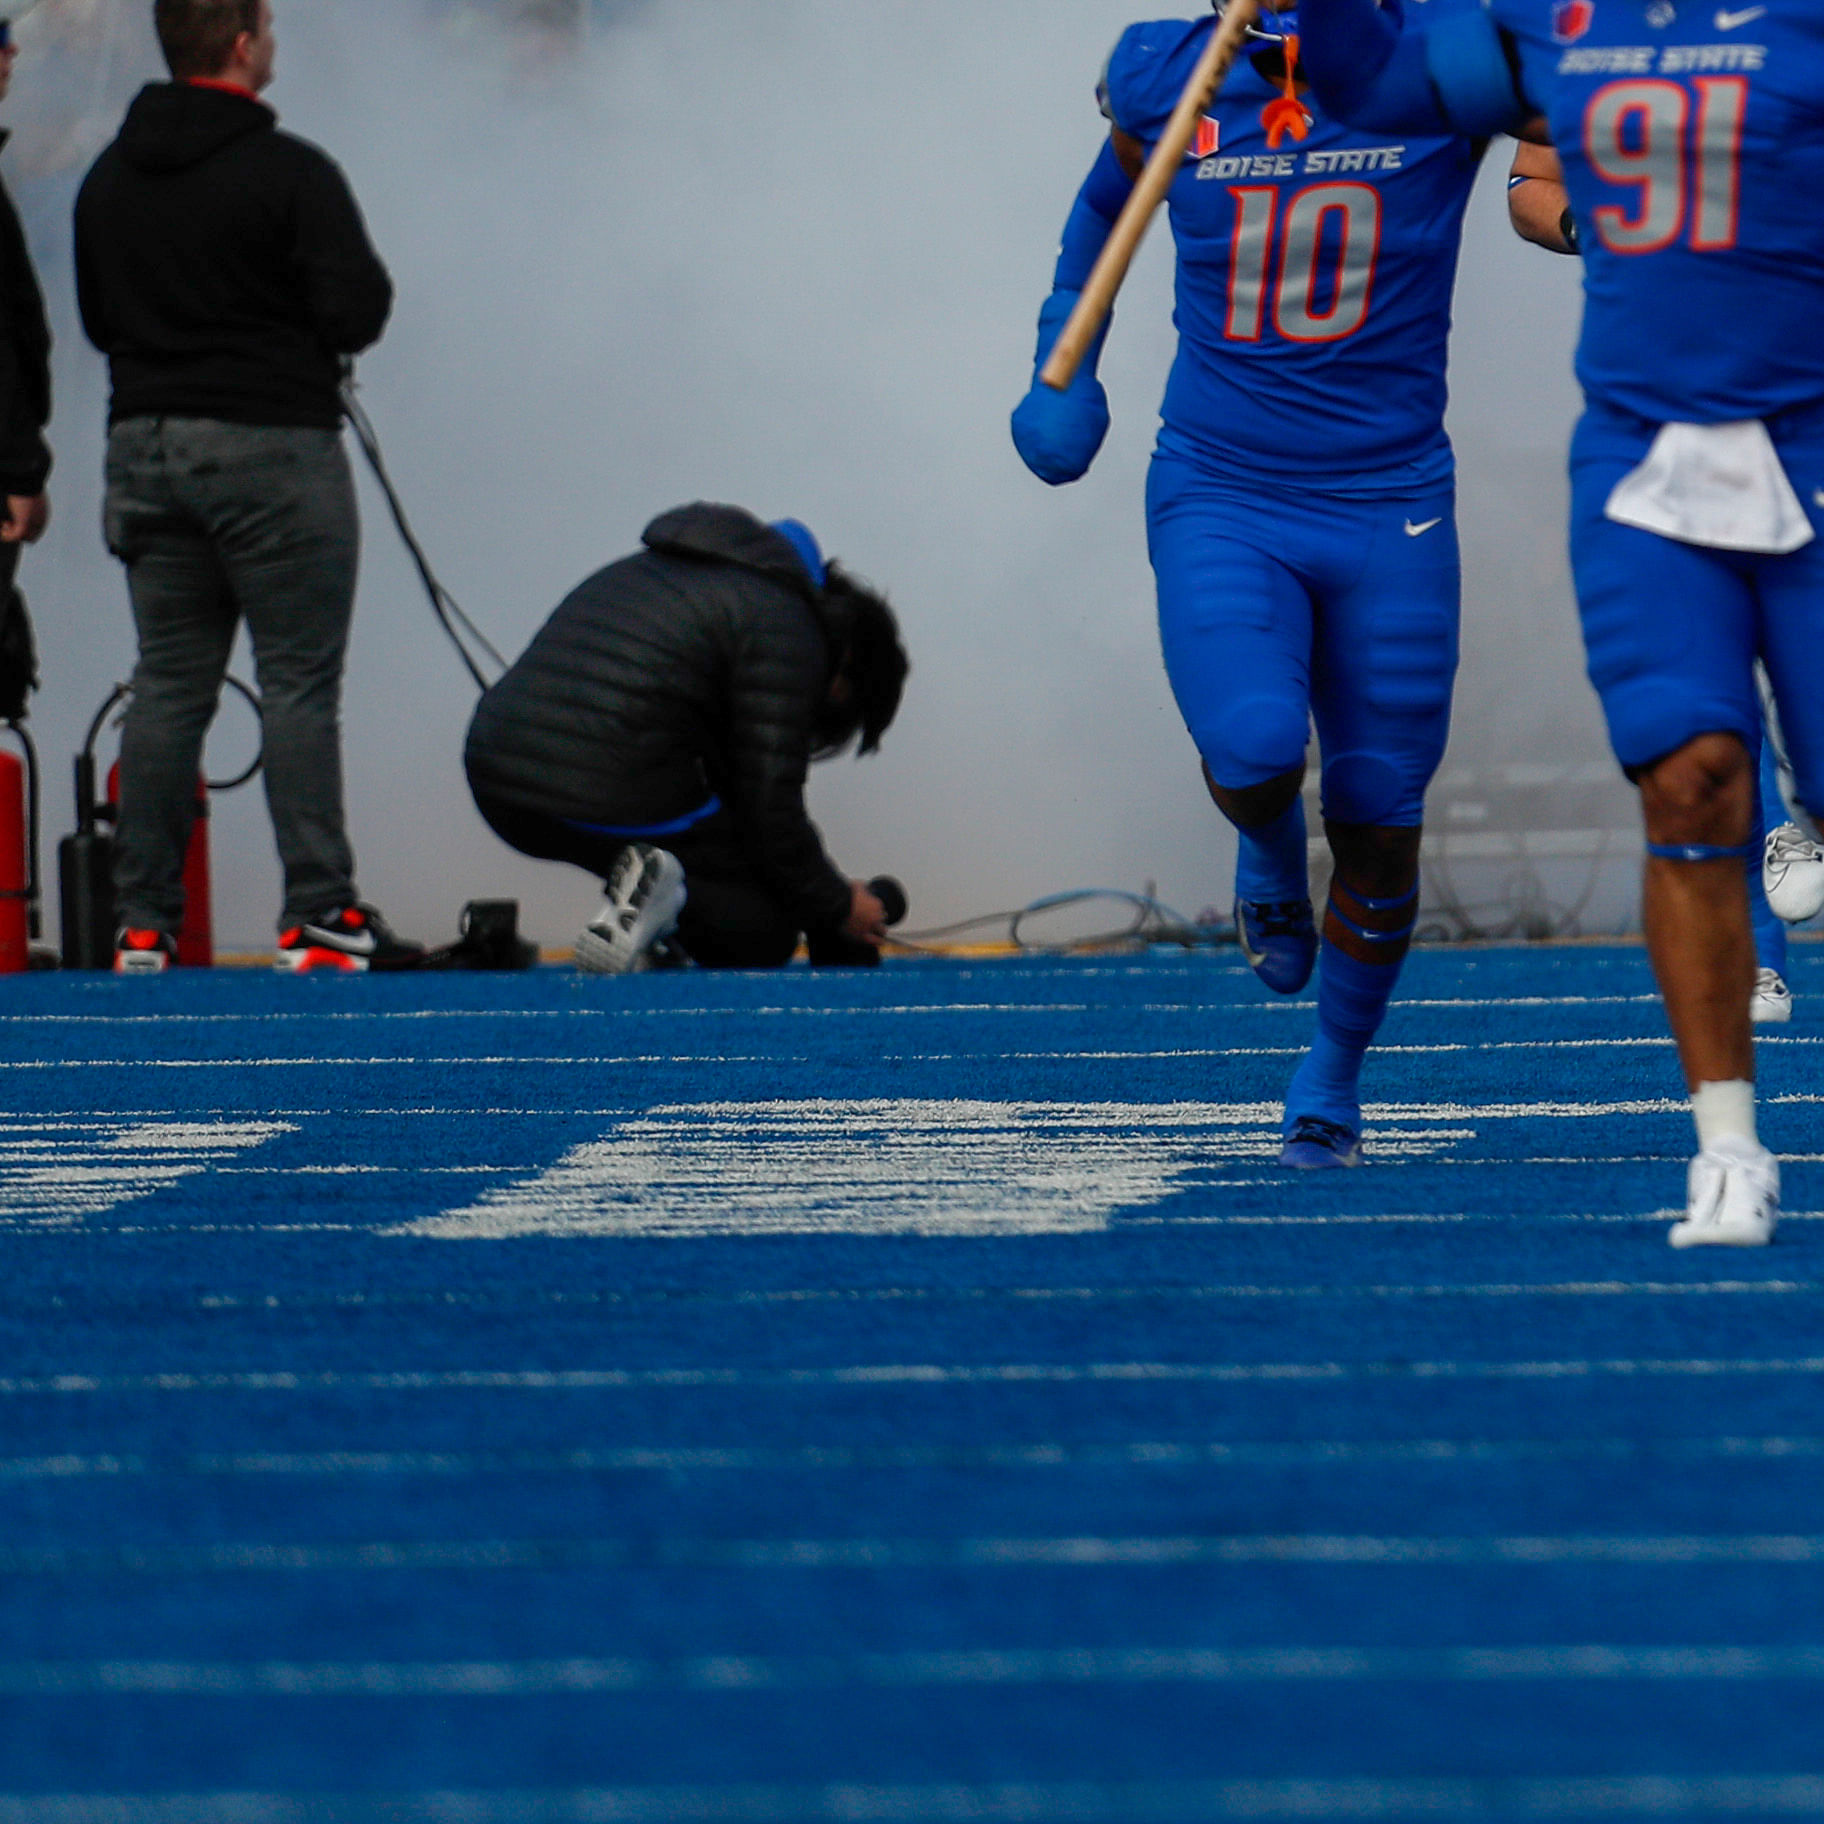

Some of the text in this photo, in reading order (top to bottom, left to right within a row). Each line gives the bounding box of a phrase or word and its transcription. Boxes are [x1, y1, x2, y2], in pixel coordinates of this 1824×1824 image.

[1659, 43, 1768, 73] STATE
[1196, 145, 1406, 180] BOISE STATE
[1582, 75, 1748, 256] 91
[1223, 180, 1383, 344] 10
